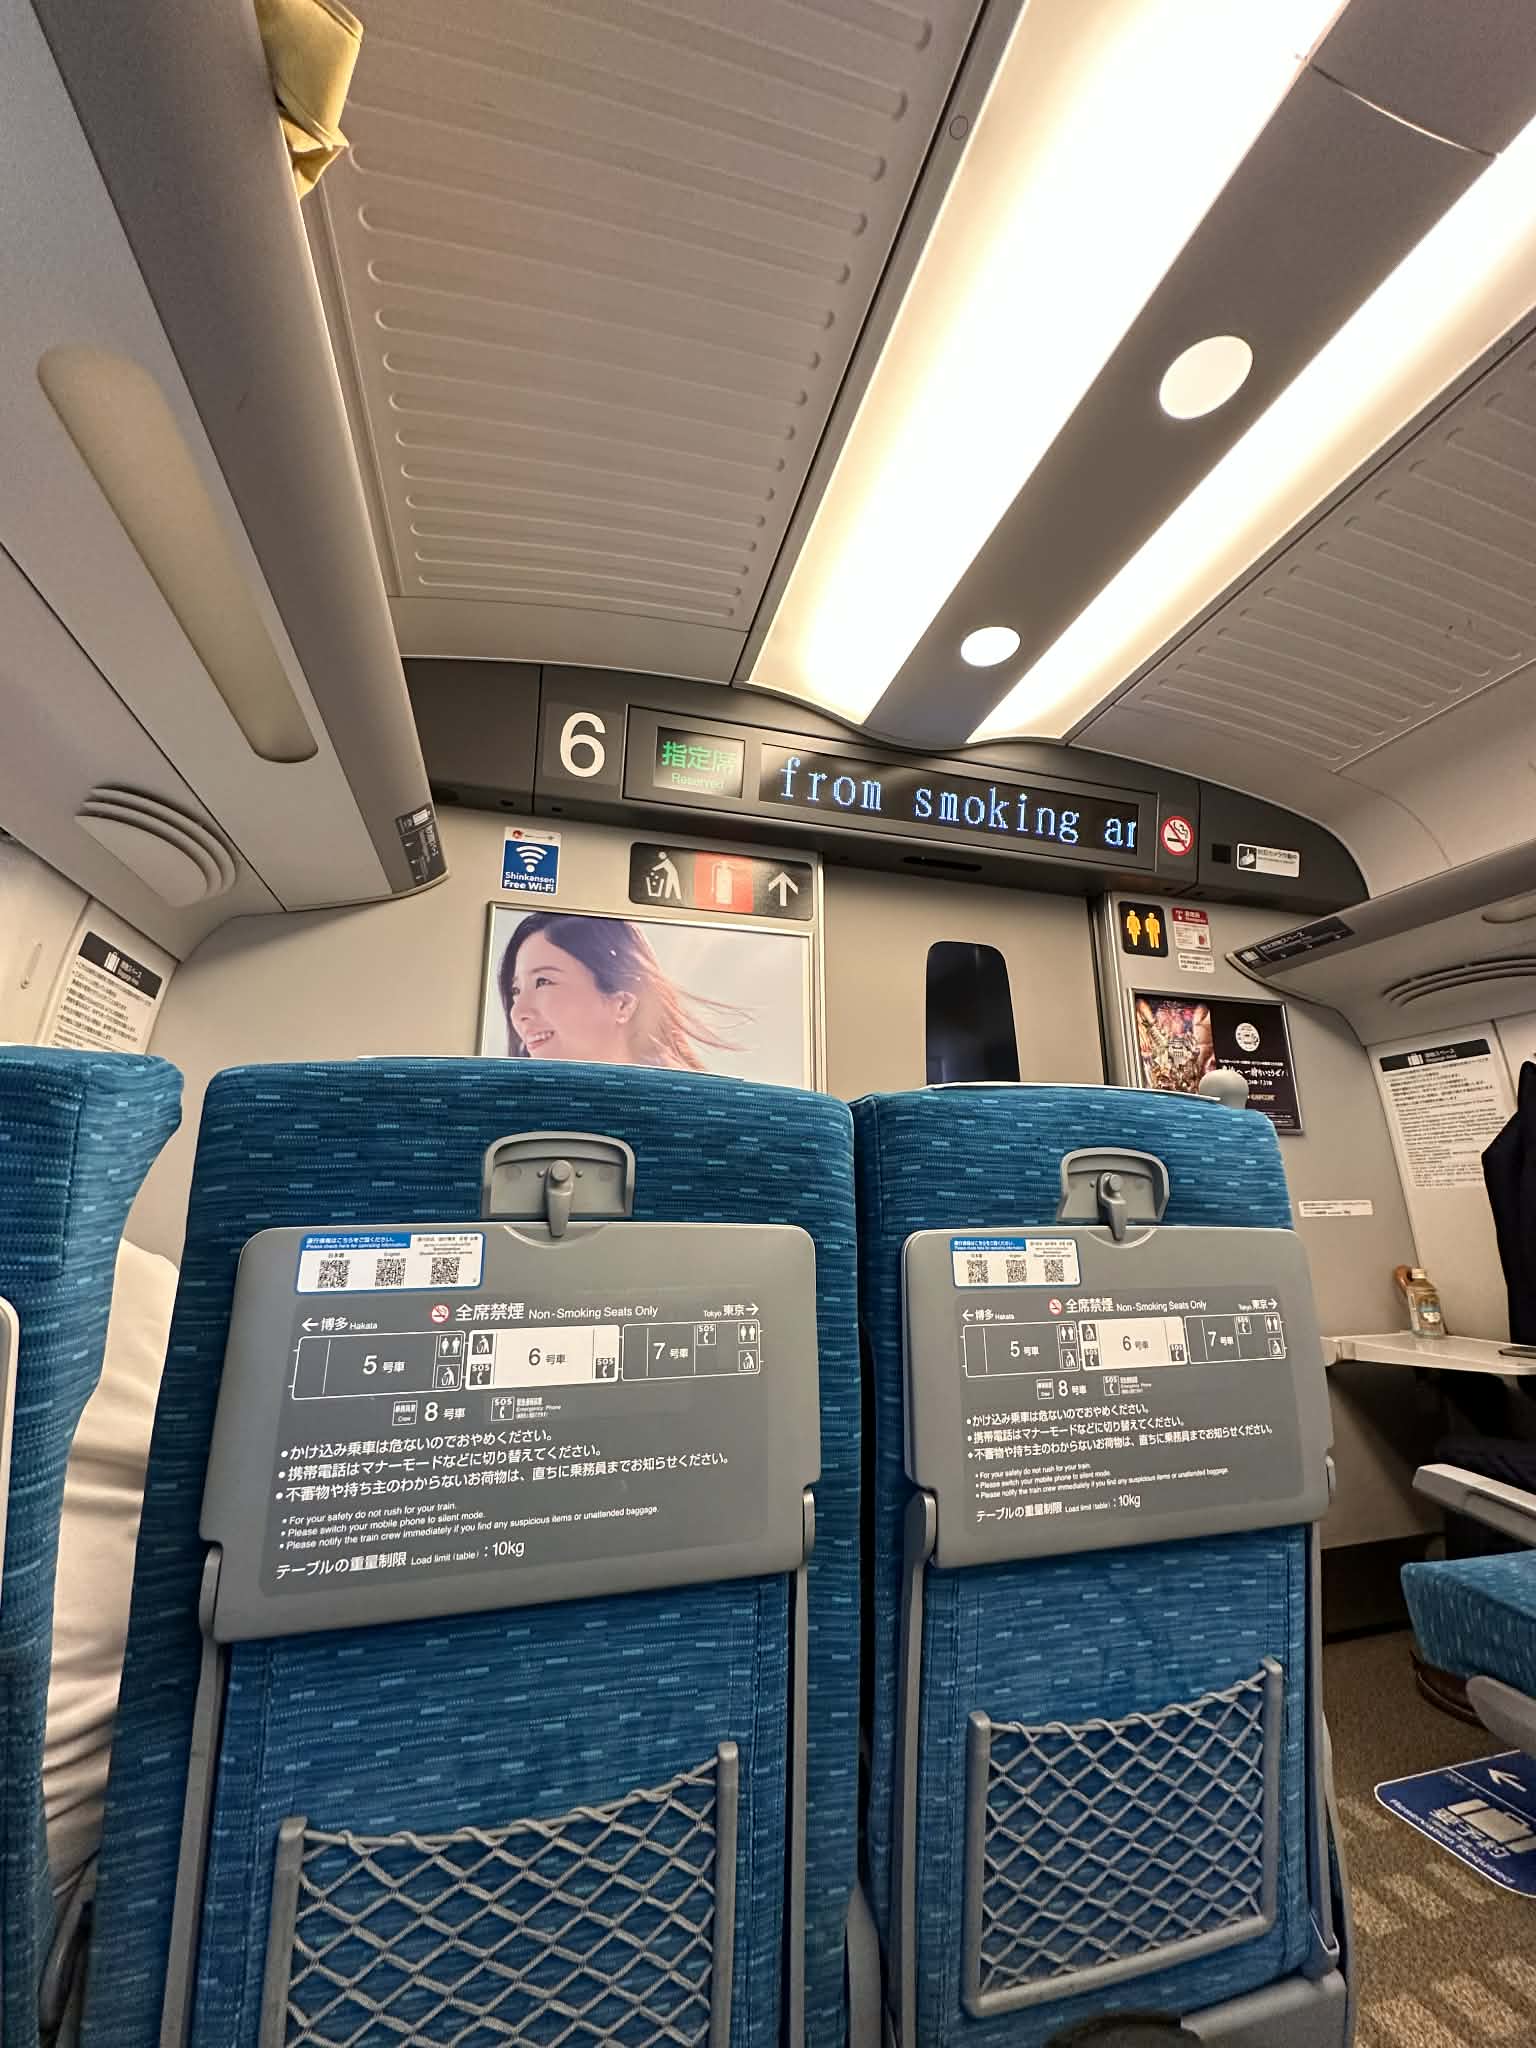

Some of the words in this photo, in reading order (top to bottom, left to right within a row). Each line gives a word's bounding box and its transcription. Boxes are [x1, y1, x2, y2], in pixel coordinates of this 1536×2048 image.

[560, 712, 605, 777] 6
[661, 741, 737, 776] 指定席
[671, 772, 725, 790] Reserved
[780, 757, 882, 811] from
[915, 786, 1080, 844] smoking
[504, 880, 526, 889] Free
[528, 882, 554, 892] Wi-Fi
[505, 872, 555, 884] Shinkansen
[455, 1303, 525, 1322] 全席禁煙
[529, 1307, 601, 1320] Non-Smoking
[604, 1307, 633, 1318] Seats
[635, 1305, 659, 1318] Only
[704, 1309, 722, 1318] Tokyo
[723, 1304, 745, 1316] 東京
[1066, 1298, 1114, 1314] 全席禁煙
[1117, 1301, 1168, 1312] Non-Smoking
[1169, 1301, 1189, 1310] Seats
[1190, 1300, 1207, 1311] Only
[1252, 1299, 1267, 1310] 東京
[321, 1317, 348, 1331] 博多
[975, 1309, 993, 1321] 博多
[698, 1325, 714, 1333] SOS
[1122, 1335, 1132, 1351] 6
[1208, 1331, 1217, 1347] 7
[528, 1348, 541, 1366] 6
[546, 1354, 566, 1364] 号車
[653, 1342, 666, 1360] 7
[669, 1348, 689, 1358] 号車
[1010, 1340, 1020, 1357] 5
[363, 1355, 377, 1375] 5
[382, 1361, 405, 1373] 号車
[472, 1364, 490, 1372] SOS
[596, 1358, 615, 1366] SOS
[1058, 1380, 1068, 1397] 8
[424, 1402, 438, 1422] 8
[443, 1408, 466, 1420] 号車
[972, 1403, 1149, 1427] かけ込み乗車は危ないのでおやめください。
[290, 1430, 552, 1460] かけ込み乗車は危ないのでおやめください。
[288, 1444, 601, 1481] 携帯電話はマナーモードなどに切り替えてください。
[980, 1471, 990, 1479] For
[991, 1471, 1004, 1480] your
[1023, 1467, 1031, 1475] do
[1042, 1466, 1055, 1474] rush
[1064, 1464, 1077, 1473] your
[980, 1481, 1000, 1489] Please
[1020, 1478, 1033, 1487] your
[1034, 1476, 1052, 1484] mobile
[1054, 1474, 1071, 1483] phone
[980, 1491, 1000, 1499] Please
[1001, 1489, 1017, 1498] notify
[1029, 1486, 1042, 1494] train
[1095, 1480, 1105, 1488] you
[289, 1516, 305, 1525] For
[306, 1515, 326, 1526] your
[327, 1511, 353, 1522] safety
[355, 1510, 366, 1519] do
[368, 1509, 382, 1518] not
[384, 1506, 401, 1516] rush
[404, 1505, 416, 1514] for
[417, 1505, 435, 1516] your
[437, 1502, 456, 1512] train.
[976, 1501, 1062, 1522] テーブルの重量制限
[1065, 1505, 1079, 1513] Load
[1118, 1493, 1141, 1508] 10kg
[286, 1540, 316, 1550] Please
[319, 1536, 342, 1548] notify
[345, 1535, 357, 1545] the
[360, 1533, 379, 1542] train
[381, 1532, 401, 1541] crew
[403, 1526, 452, 1538] immediately
[453, 1525, 459, 1534] if
[460, 1524, 476, 1534] you
[477, 1521, 492, 1531] find
[494, 1520, 508, 1530] any
[510, 1517, 550, 1528] suspicious
[552, 1513, 572, 1523] items
[574, 1512, 582, 1521] or
[584, 1508, 625, 1520] unattended
[288, 1527, 317, 1537] Please
[319, 1524, 347, 1535] switch
[349, 1523, 369, 1534] your
[370, 1519, 397, 1530] mobile
[400, 1518, 425, 1529] phone
[428, 1515, 436, 1524] to
[437, 1513, 459, 1523] silent
[461, 1511, 485, 1520] mode.
[276, 1551, 407, 1580] テーブルの重量制限
[411, 1555, 432, 1566] Load
[434, 1553, 451, 1563] limit
[453, 1551, 480, 1562] (table)
[492, 1540, 525, 1558] 10kg
